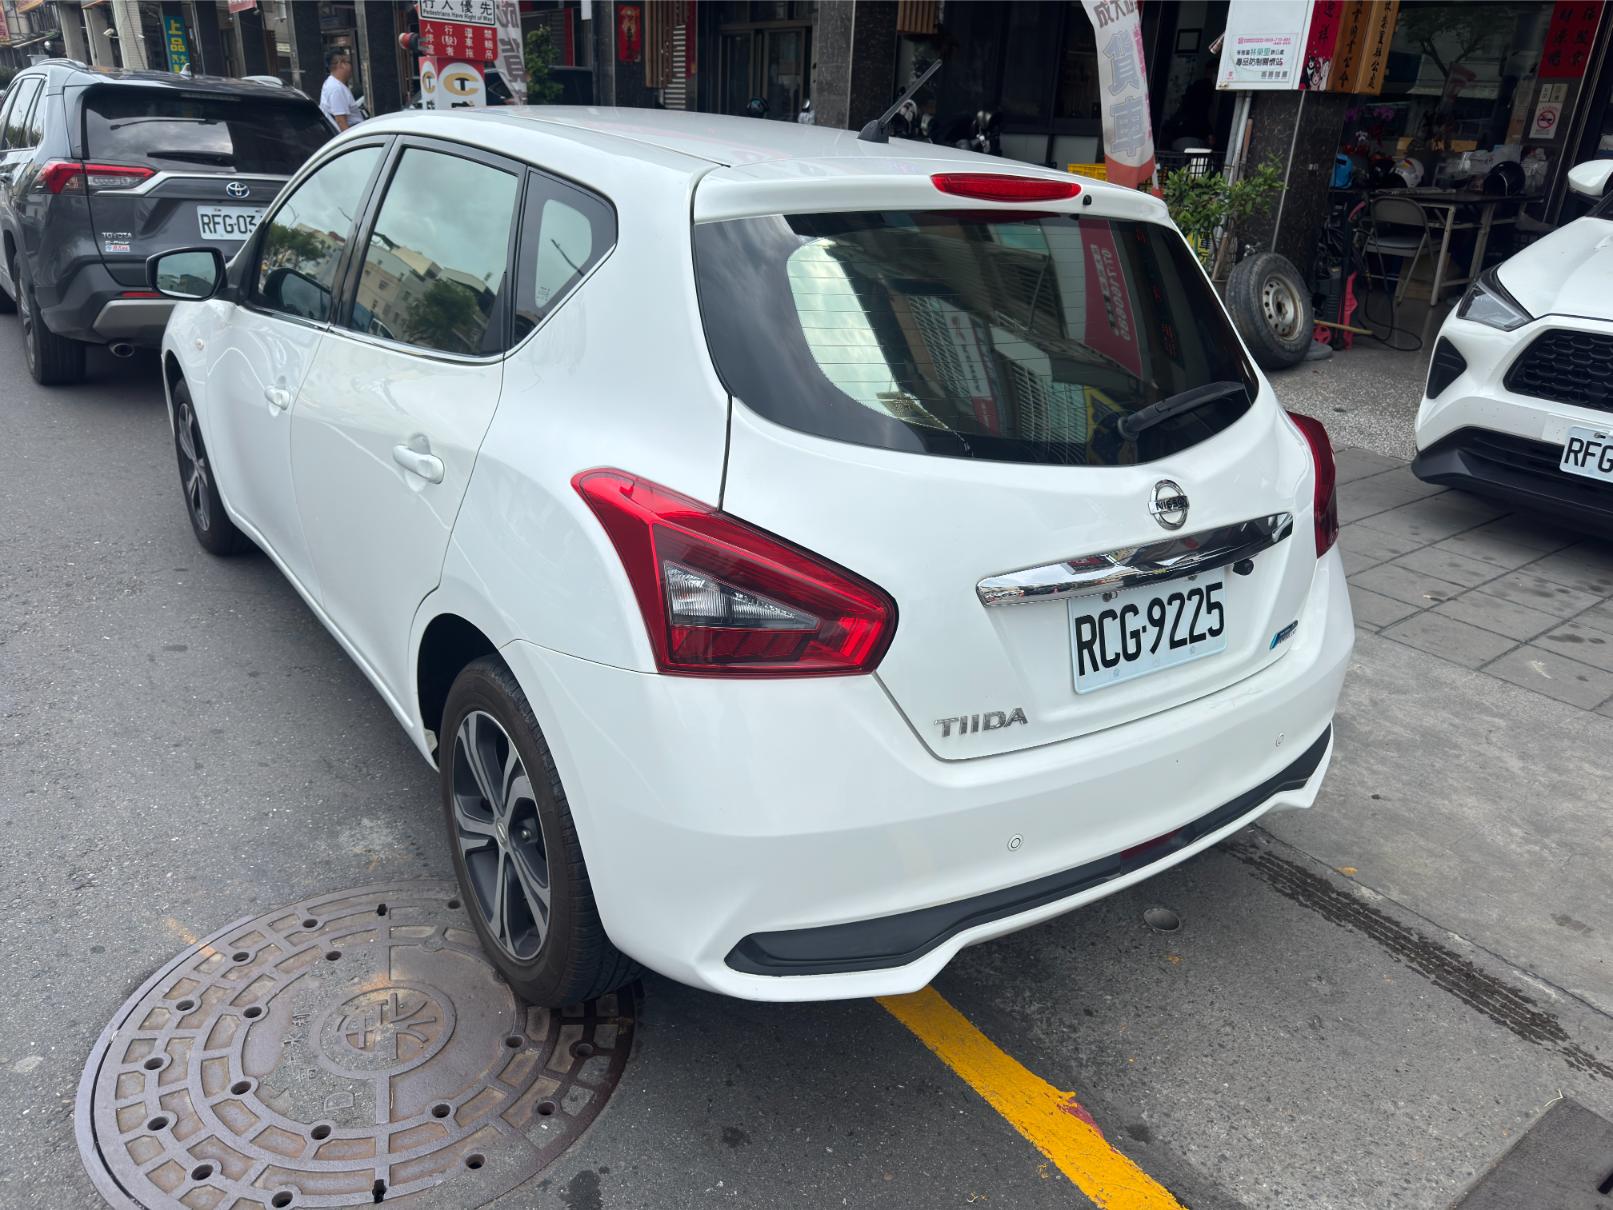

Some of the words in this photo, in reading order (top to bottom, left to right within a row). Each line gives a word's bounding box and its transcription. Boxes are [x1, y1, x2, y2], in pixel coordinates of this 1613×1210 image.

[423, 0, 493, 15] 行人優先
[102, 231, 133, 239] TOYOTA
[934, 707, 1028, 738] TIIDA
